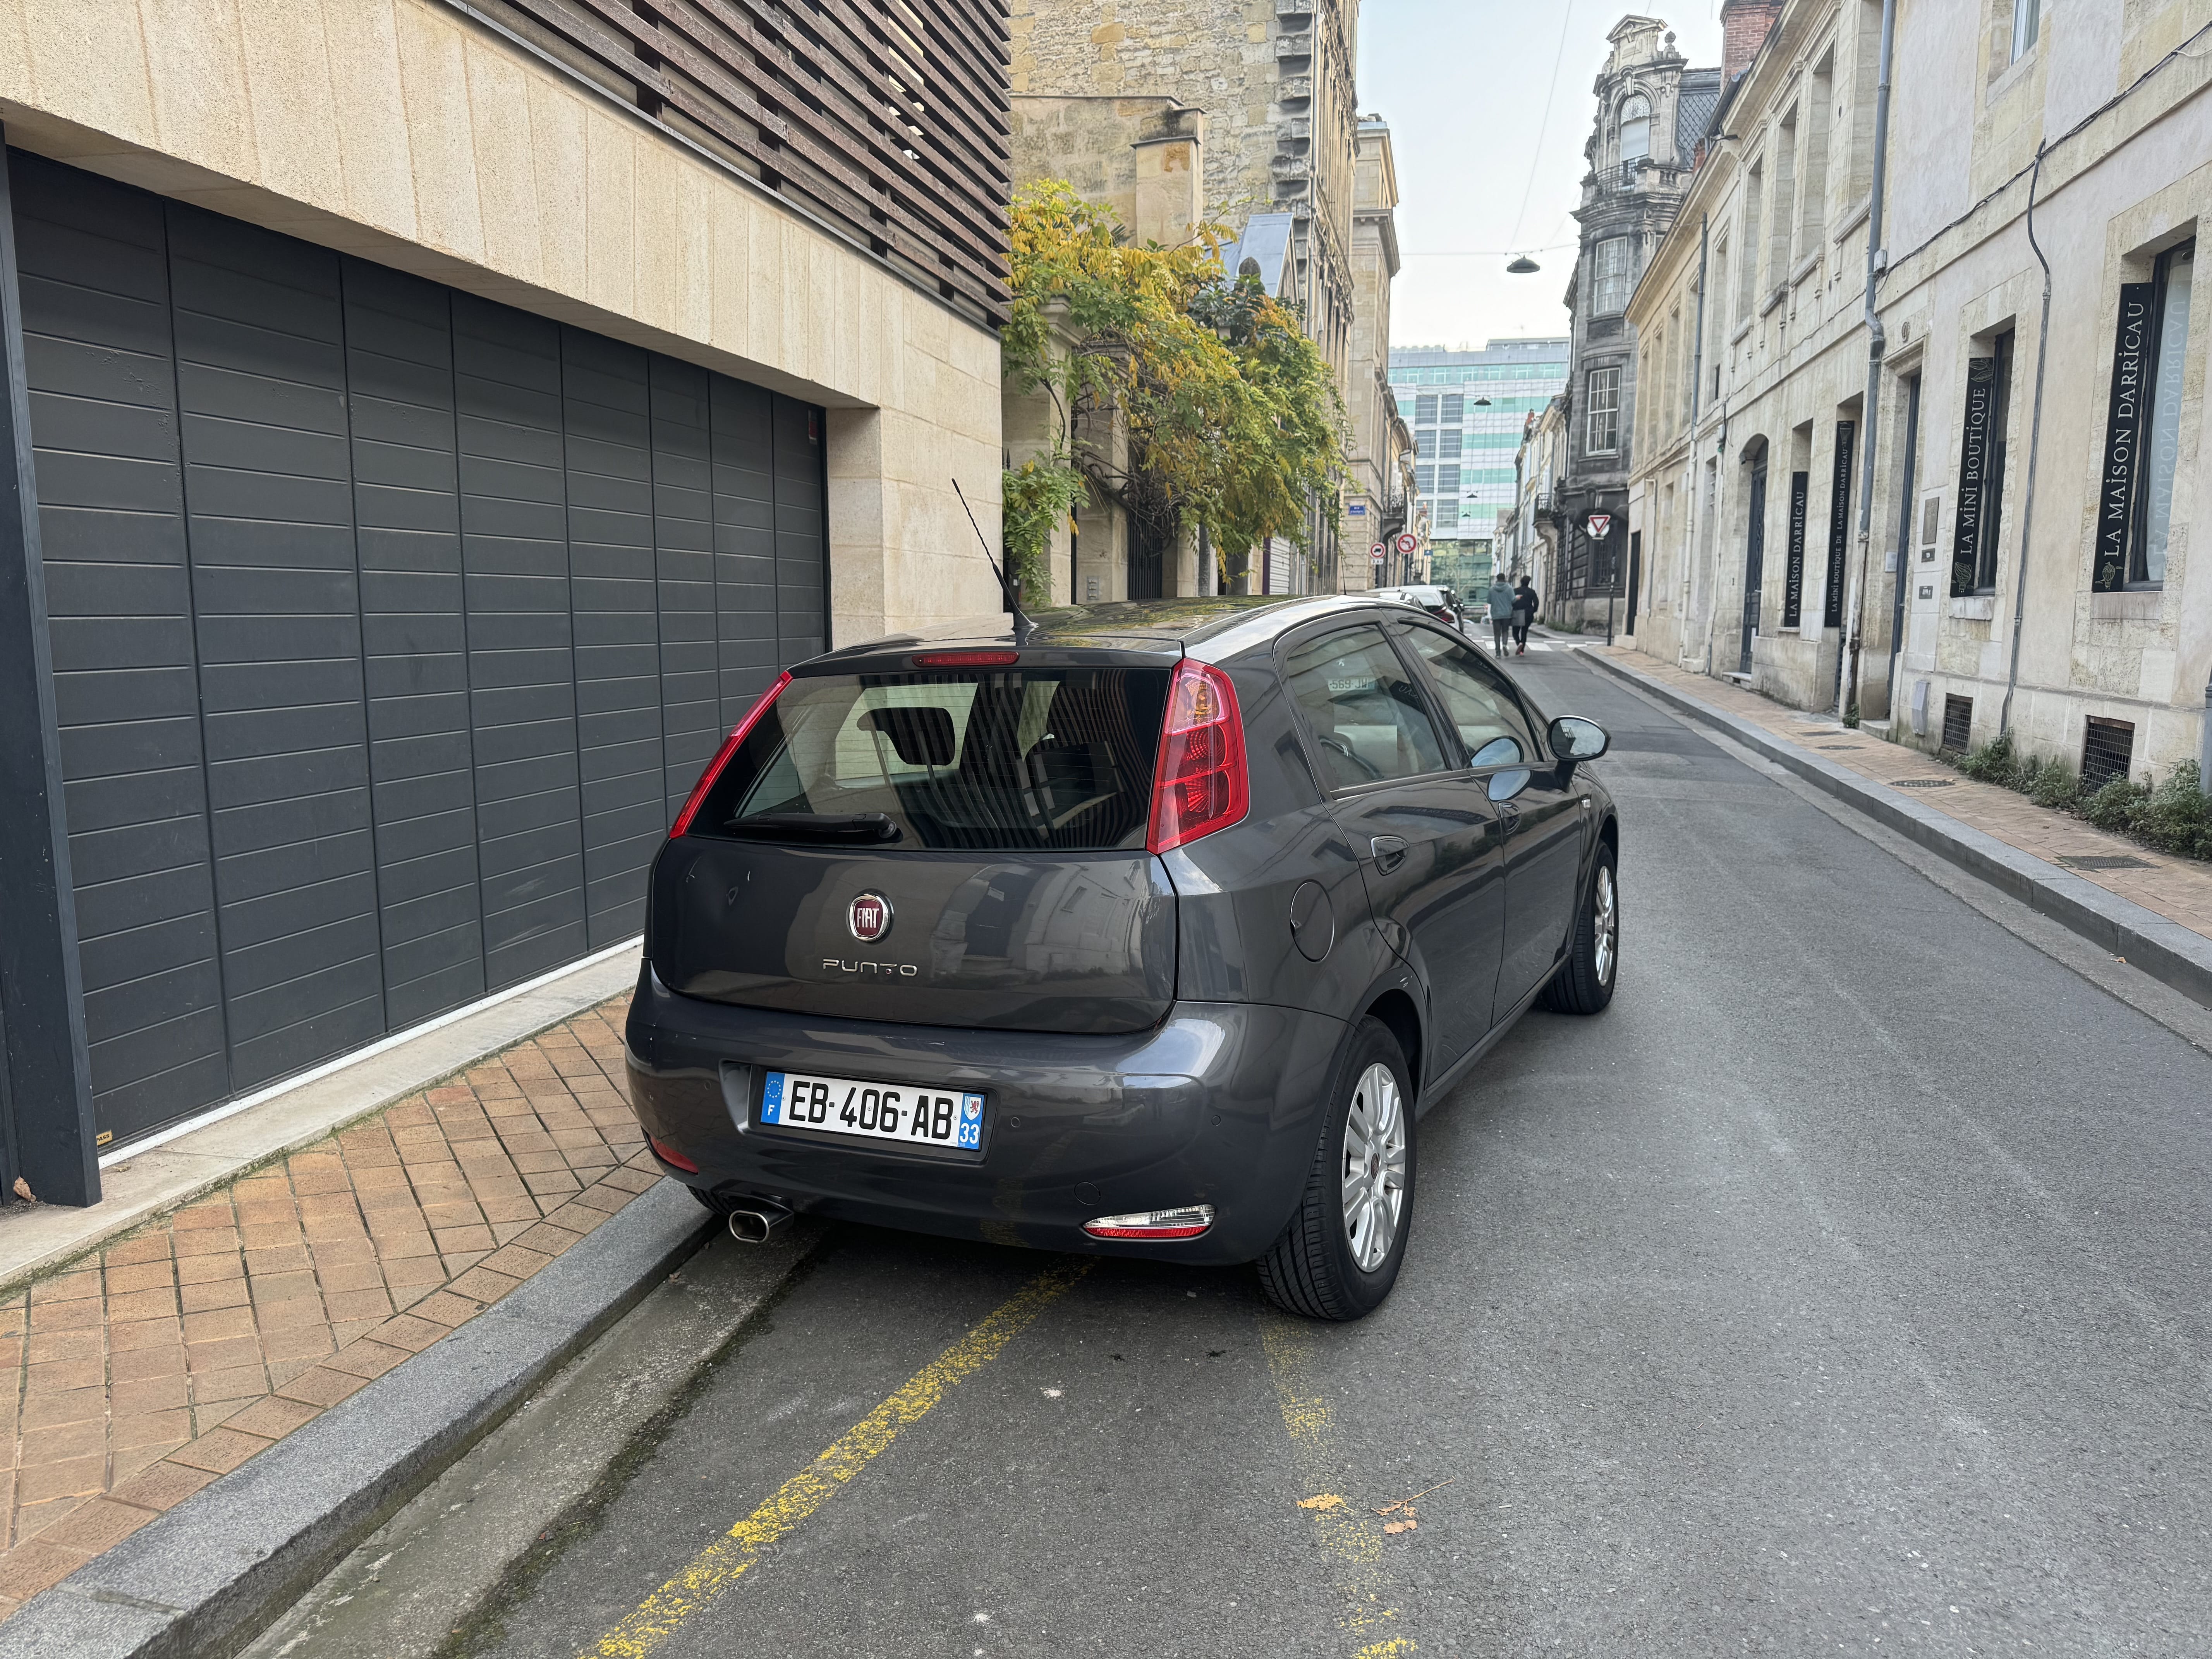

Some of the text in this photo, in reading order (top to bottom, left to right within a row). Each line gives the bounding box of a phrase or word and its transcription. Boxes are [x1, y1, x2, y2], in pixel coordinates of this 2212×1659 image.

[1837, 520, 1843, 529] LA
[1836, 535, 1841, 544] DE
[1960, 533, 1973, 555] LA
[2104, 529, 2121, 556] LA
[1790, 603, 1797, 617] LA
[1831, 603, 1838, 612] LA
[857, 908, 879, 928] FIAT
[823, 958, 918, 976] PUNTO
[768, 1104, 775, 1116] F
[789, 1080, 954, 1139] EB-406-AB
[960, 1123, 979, 1144] 33
